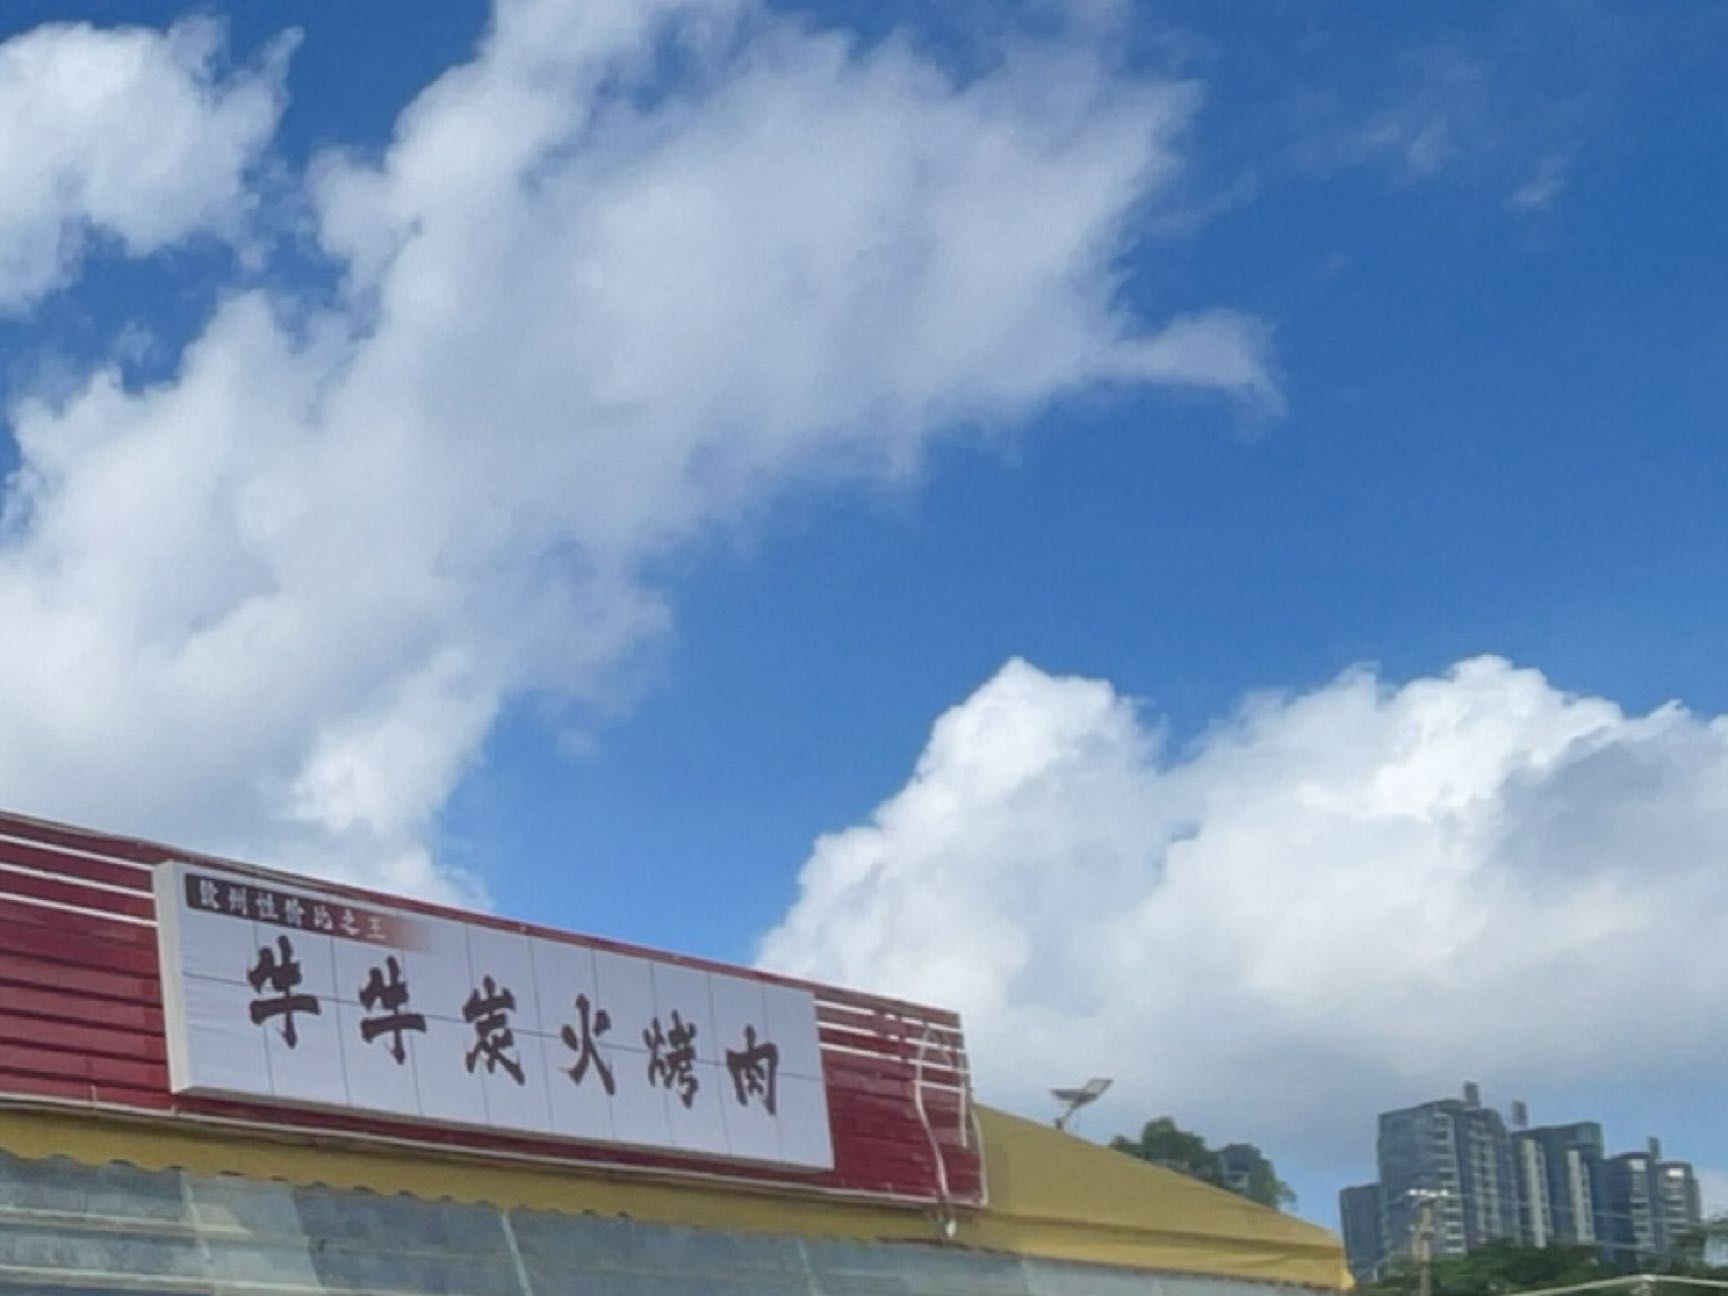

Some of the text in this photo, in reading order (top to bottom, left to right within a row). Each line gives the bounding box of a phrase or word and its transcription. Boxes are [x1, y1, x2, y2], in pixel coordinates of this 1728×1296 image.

[246, 935, 780, 1115] 牛牛炭火烤肉
